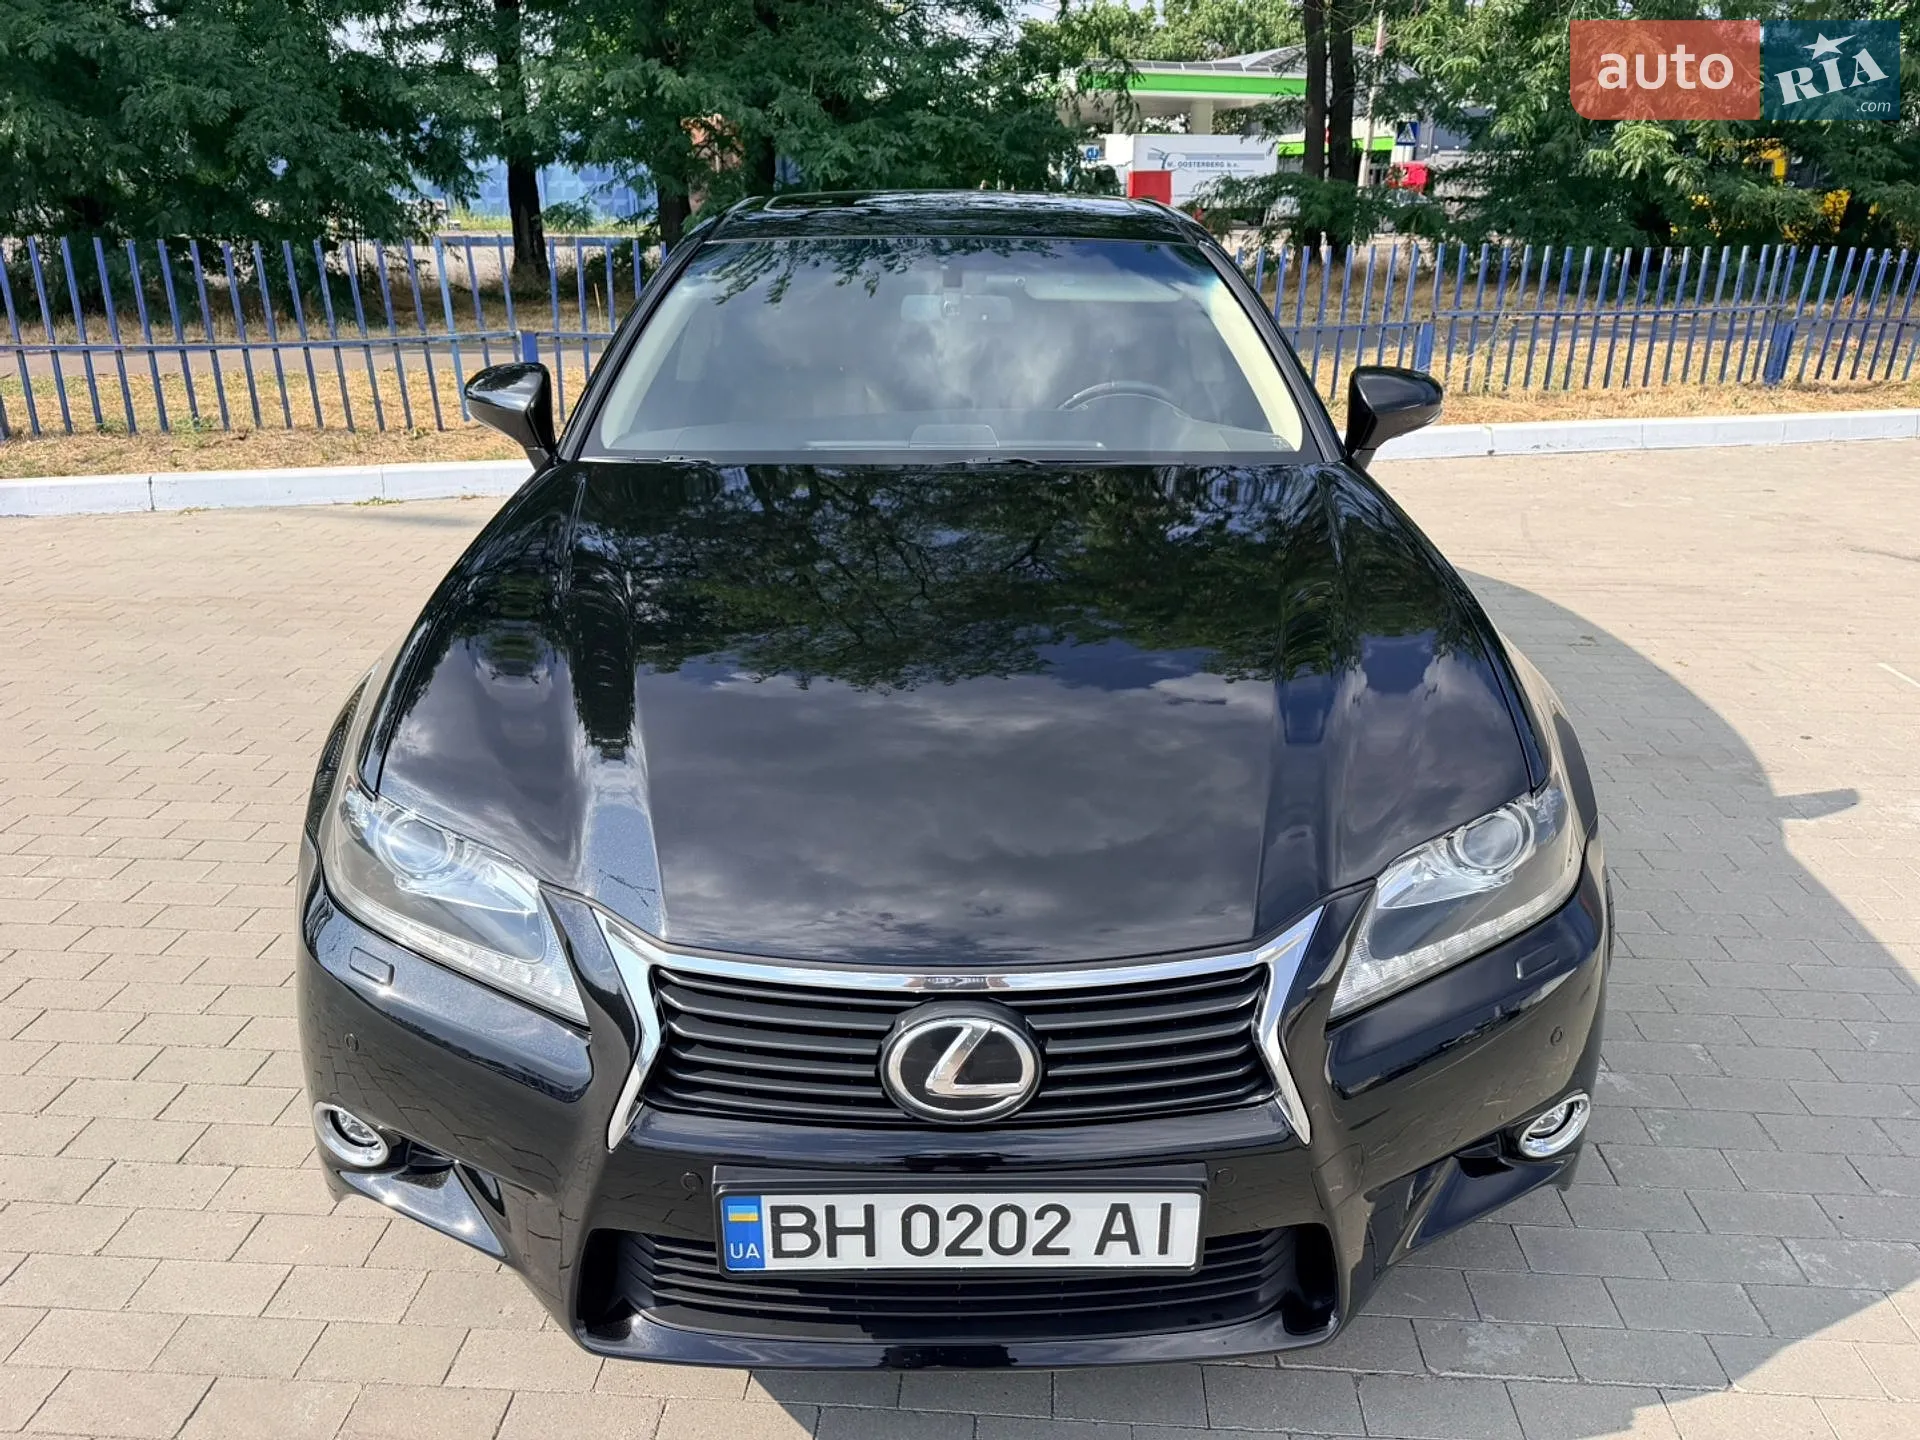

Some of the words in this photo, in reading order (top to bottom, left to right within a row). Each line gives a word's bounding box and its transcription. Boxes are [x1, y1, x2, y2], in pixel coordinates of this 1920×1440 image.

[769, 1203, 876, 1259] BH
[900, 1203, 1071, 1258] 0202
[1094, 1202, 1172, 1257] AI
[730, 1243, 761, 1260] UA
